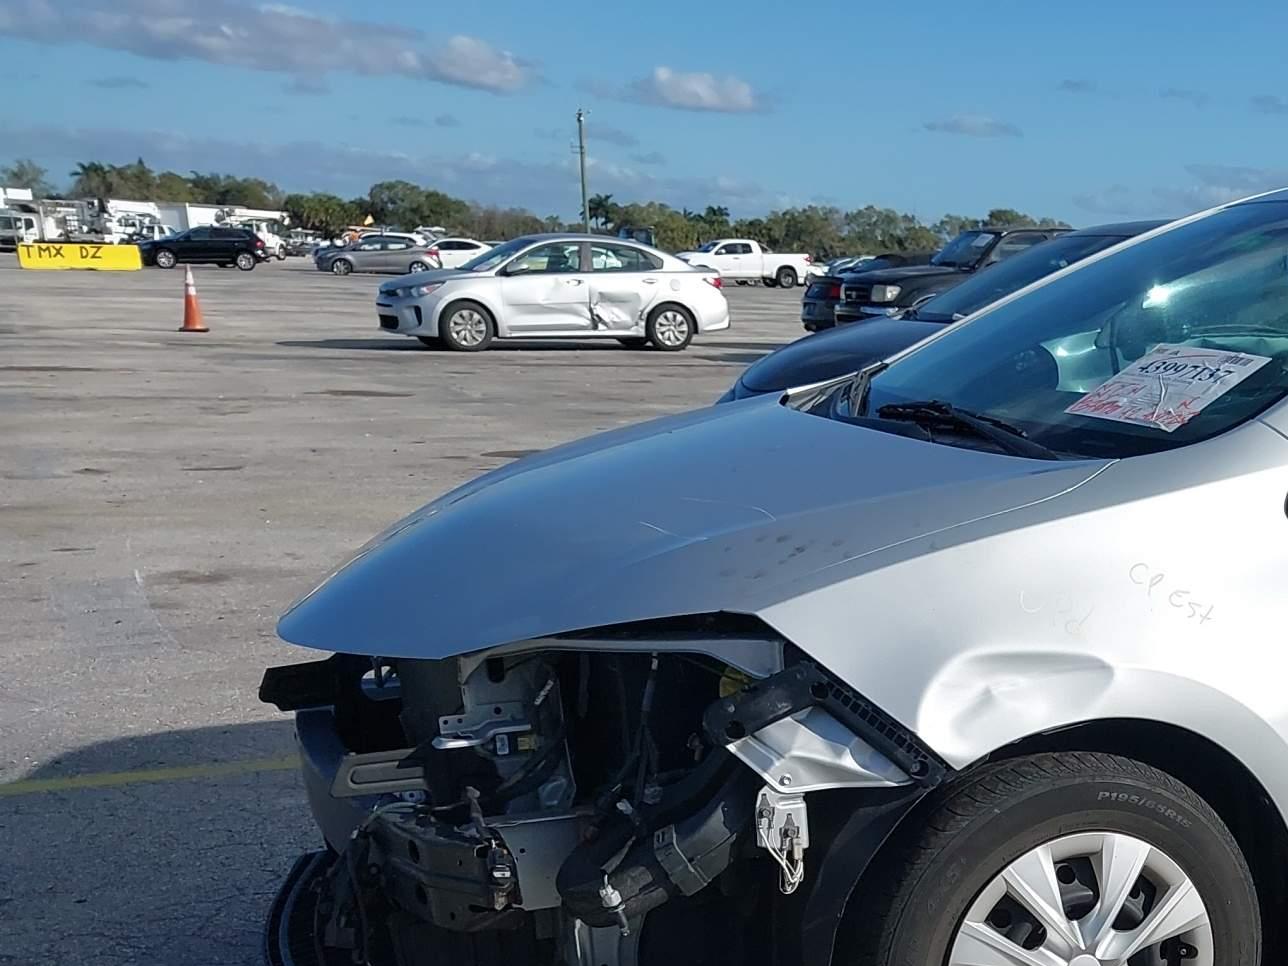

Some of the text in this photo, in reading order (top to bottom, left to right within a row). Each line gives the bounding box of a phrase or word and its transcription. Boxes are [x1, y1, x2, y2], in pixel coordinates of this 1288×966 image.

[21, 244, 105, 259] TMX DZ
[1138, 359, 1237, 385] 43997137
[1097, 791, 1192, 828] P195/65R15
